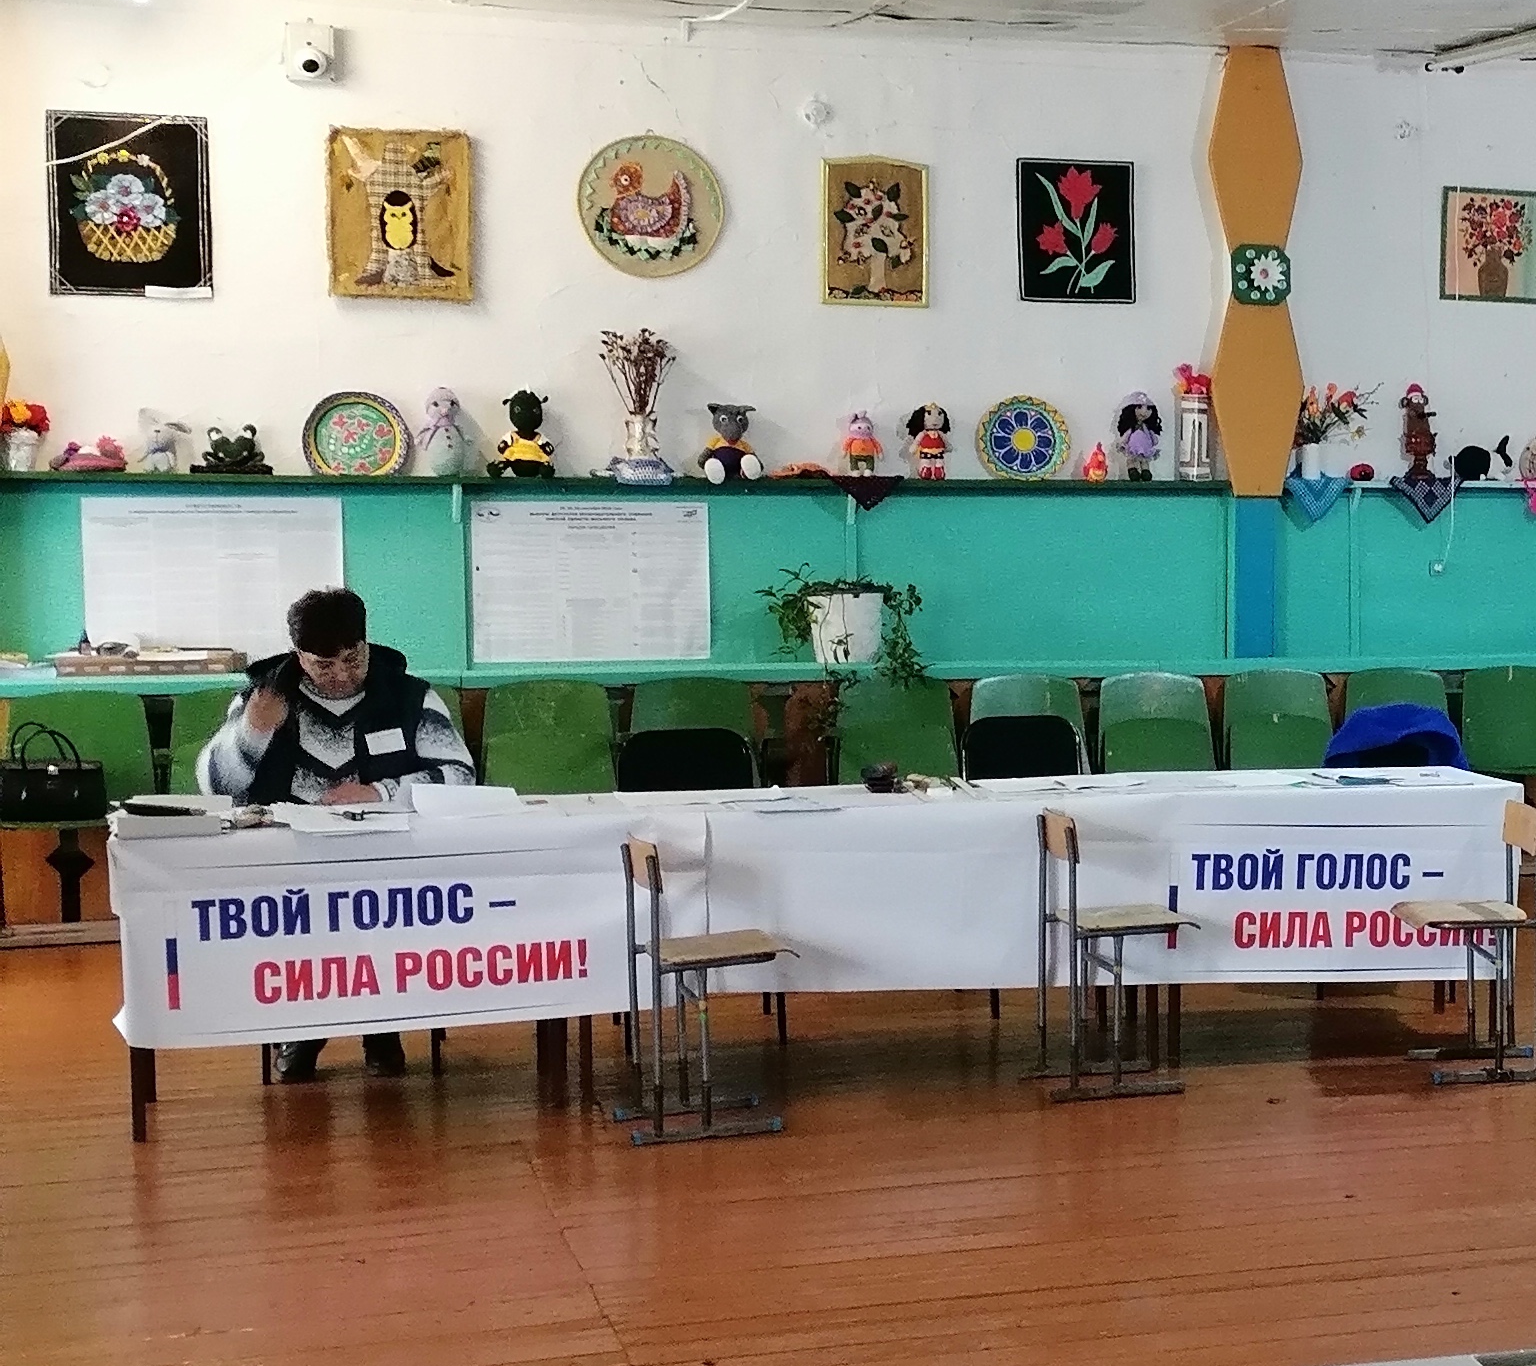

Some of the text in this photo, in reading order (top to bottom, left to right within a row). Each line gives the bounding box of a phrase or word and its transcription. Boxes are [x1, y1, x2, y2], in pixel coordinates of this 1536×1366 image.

[1191, 848, 1284, 891] ТВОЙ
[1296, 852, 1411, 891] ГОЛОС
[191, 888, 311, 942] ТВОЙ
[327, 882, 474, 933] ГОЛОС
[1233, 910, 1333, 949] СИЛА
[253, 938, 589, 1005] СИЛА РОССИИ!
